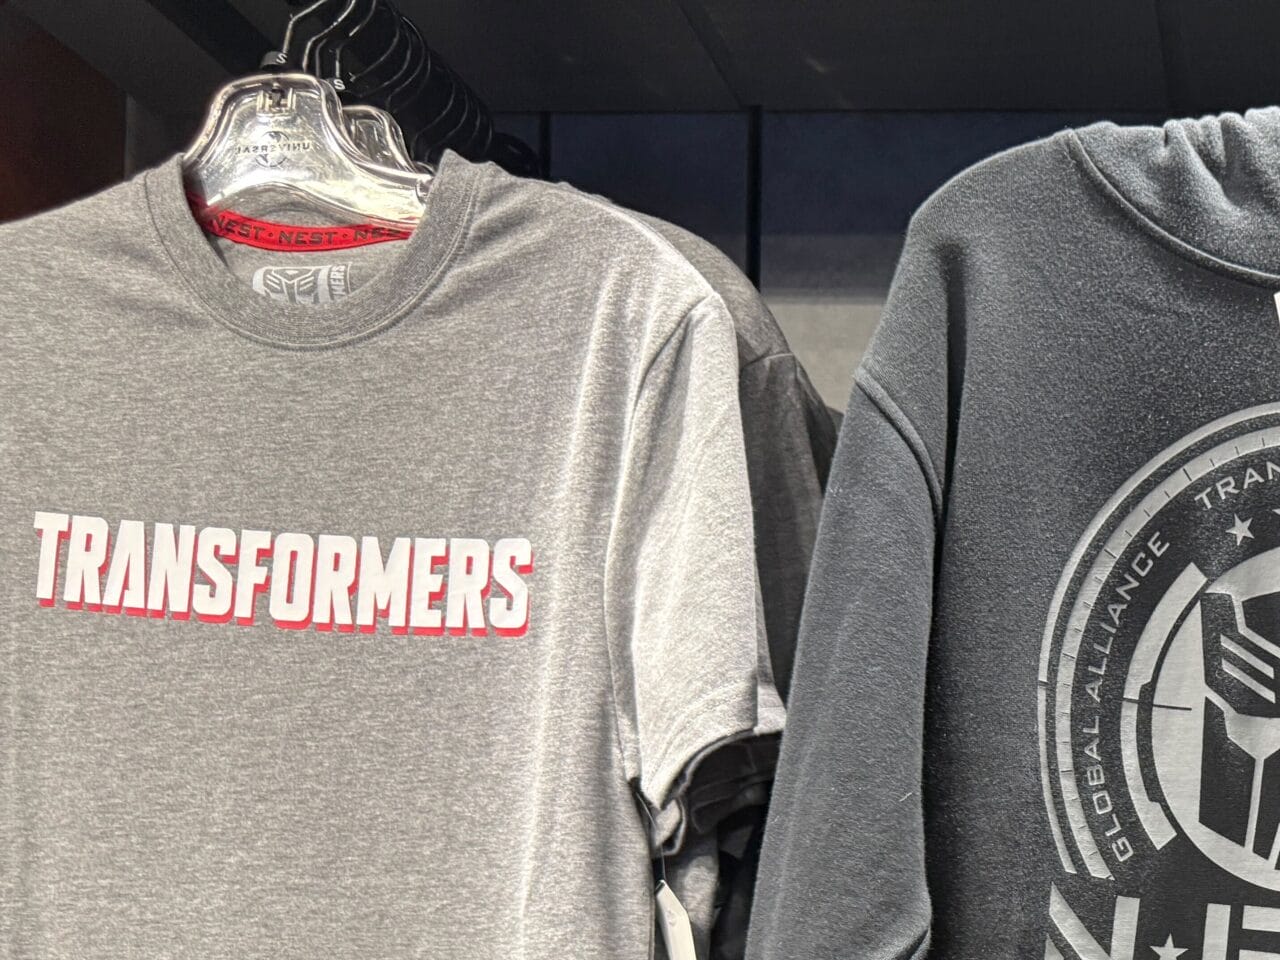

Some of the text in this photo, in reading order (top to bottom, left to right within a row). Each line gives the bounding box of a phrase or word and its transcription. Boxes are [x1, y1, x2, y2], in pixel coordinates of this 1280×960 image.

[333, 79, 345, 90] S
[278, 230, 337, 245] NEST
[33, 510, 533, 637] TRANSFORMERS
[1083, 531, 1171, 862] GLOBAL ALLIANCE
